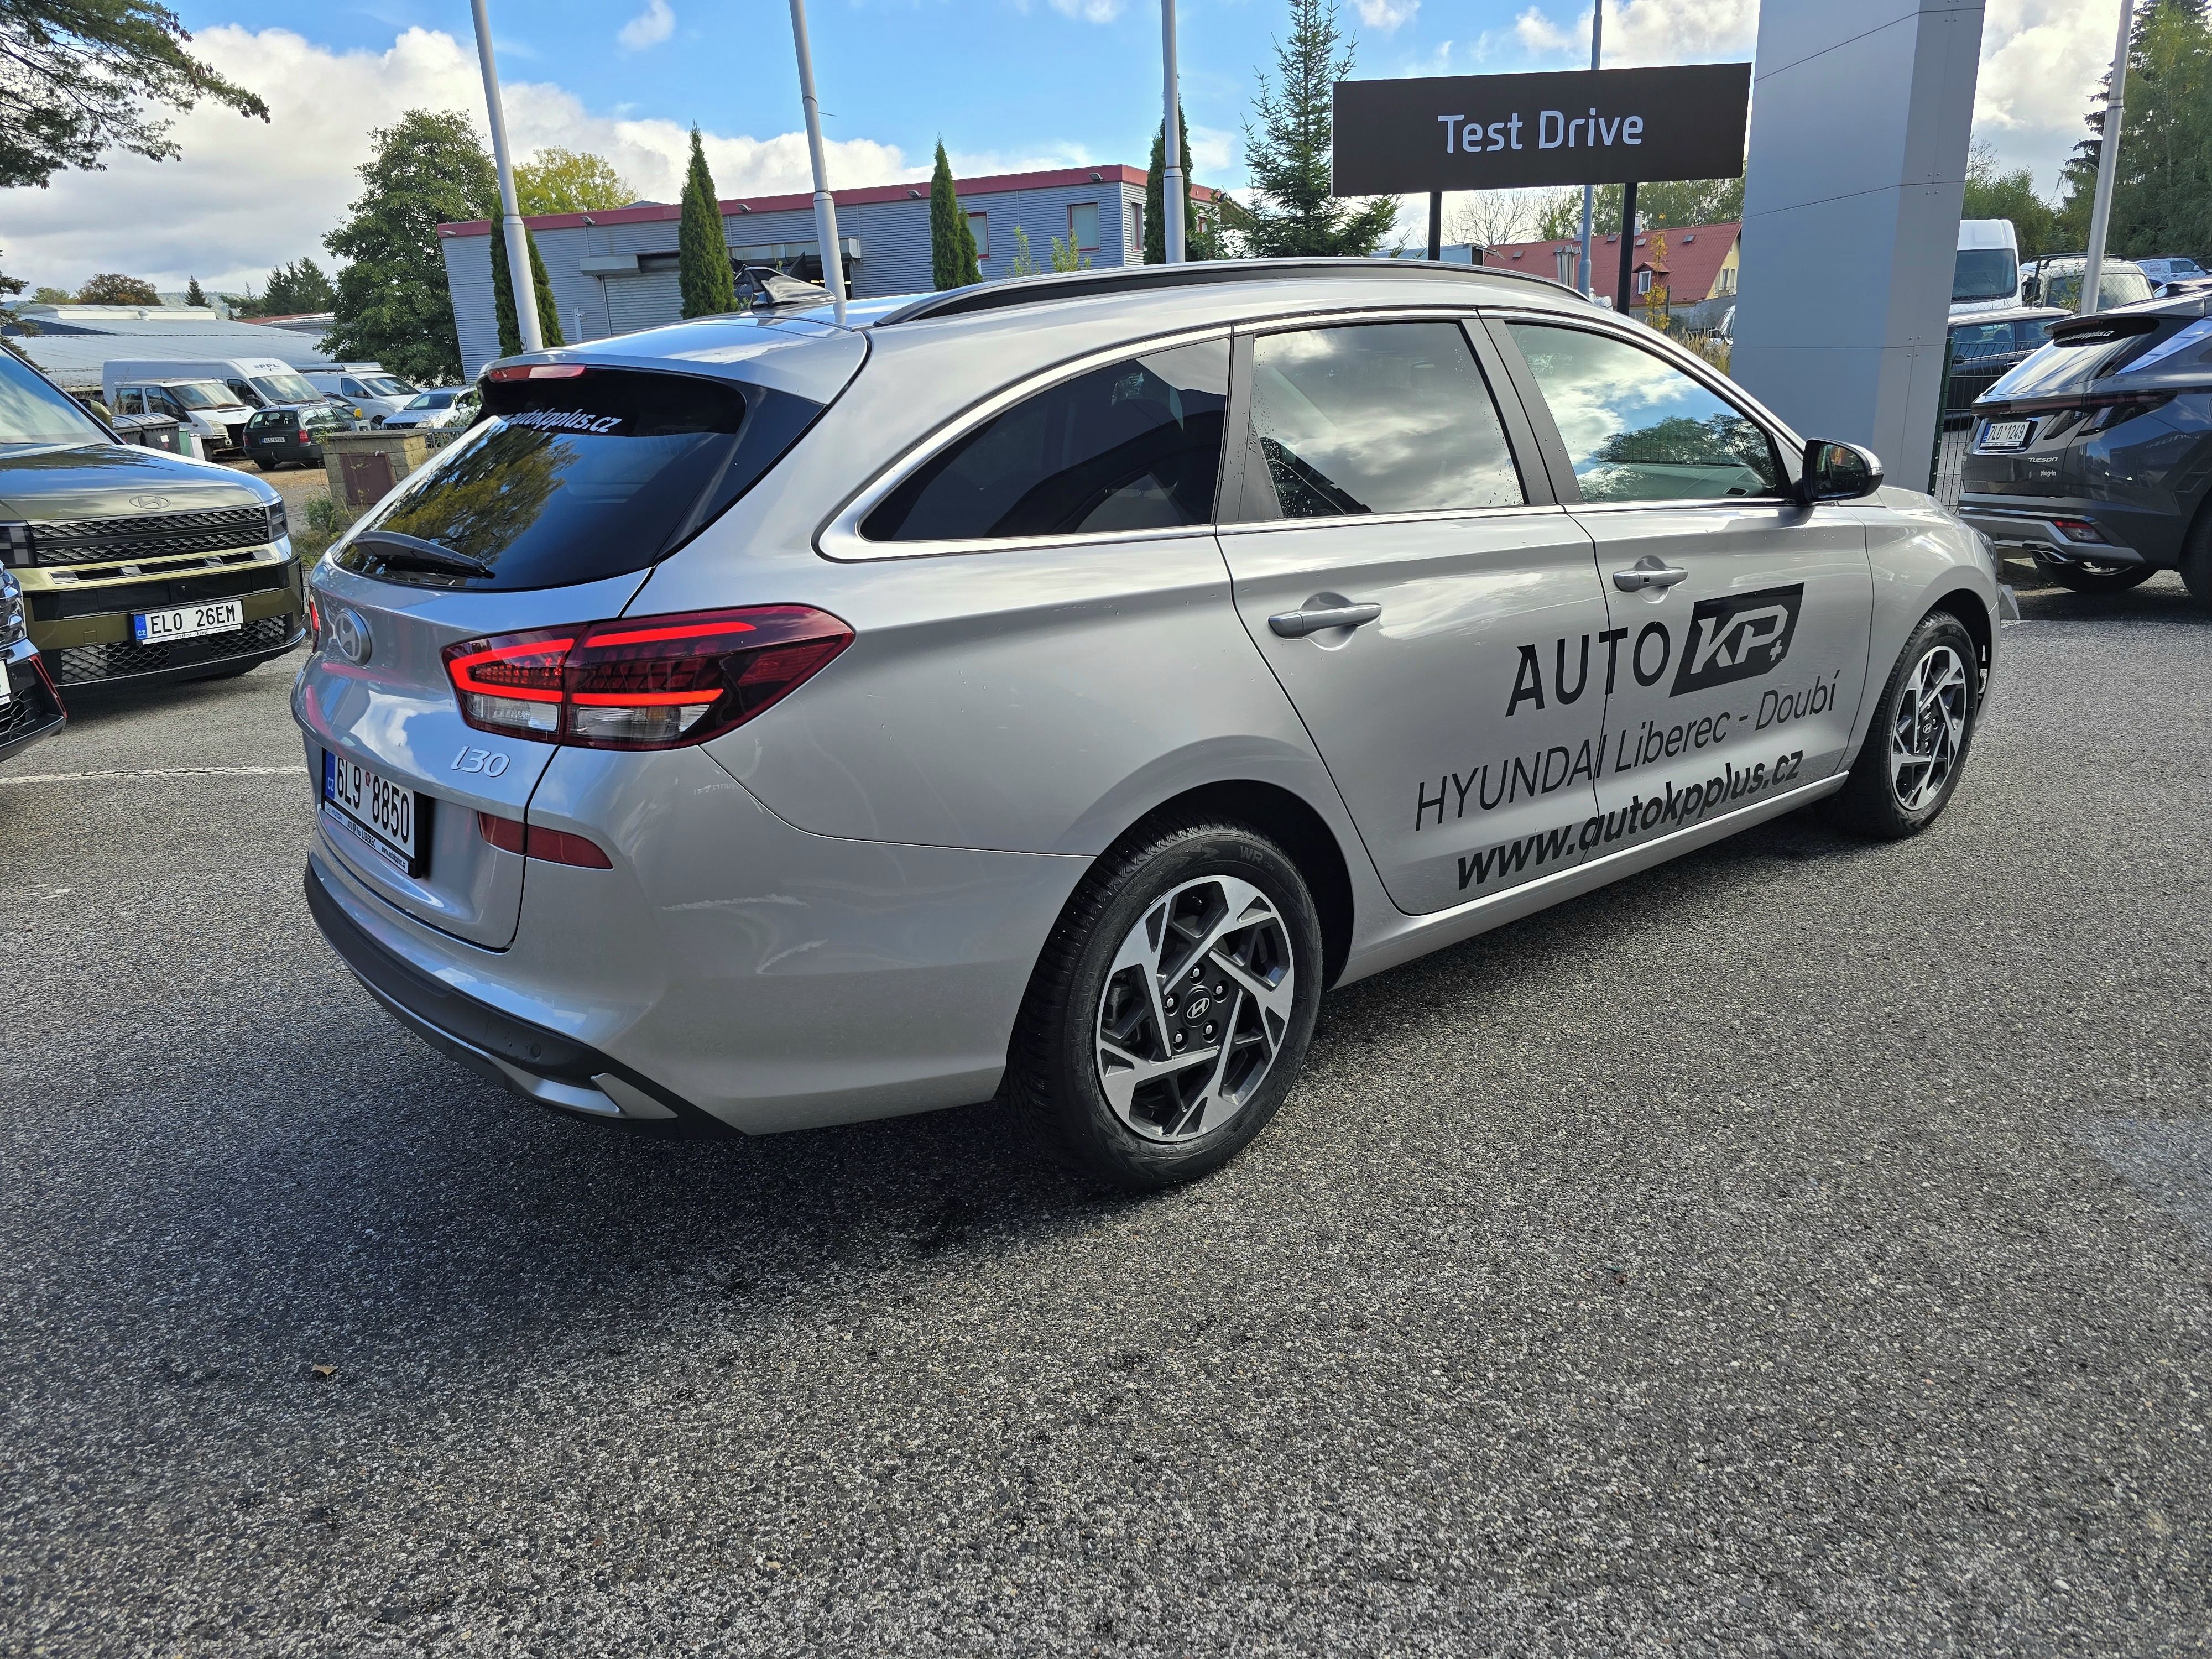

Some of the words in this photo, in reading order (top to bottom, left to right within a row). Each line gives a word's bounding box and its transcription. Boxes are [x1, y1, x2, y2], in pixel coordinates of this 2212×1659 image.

[1438, 113, 1523, 153] Test
[1538, 108, 1644, 149] Drive
[2006, 424, 2026, 440] 1249
[195, 604, 236, 628] 26EM
[1505, 620, 1671, 717] AUTO
[1416, 734, 1608, 832] HYUNDAI
[1615, 712, 1730, 773] Liberec
[1755, 669, 1841, 731] Doubí
[327, 776, 335, 792] CZ
[337, 757, 361, 810] 6L9
[372, 775, 410, 844] 8850
[1457, 750, 1803, 890] www.autokpplus.cz
[362, 830, 376, 848] LIBEREC
[1240, 846, 1264, 864] WR
